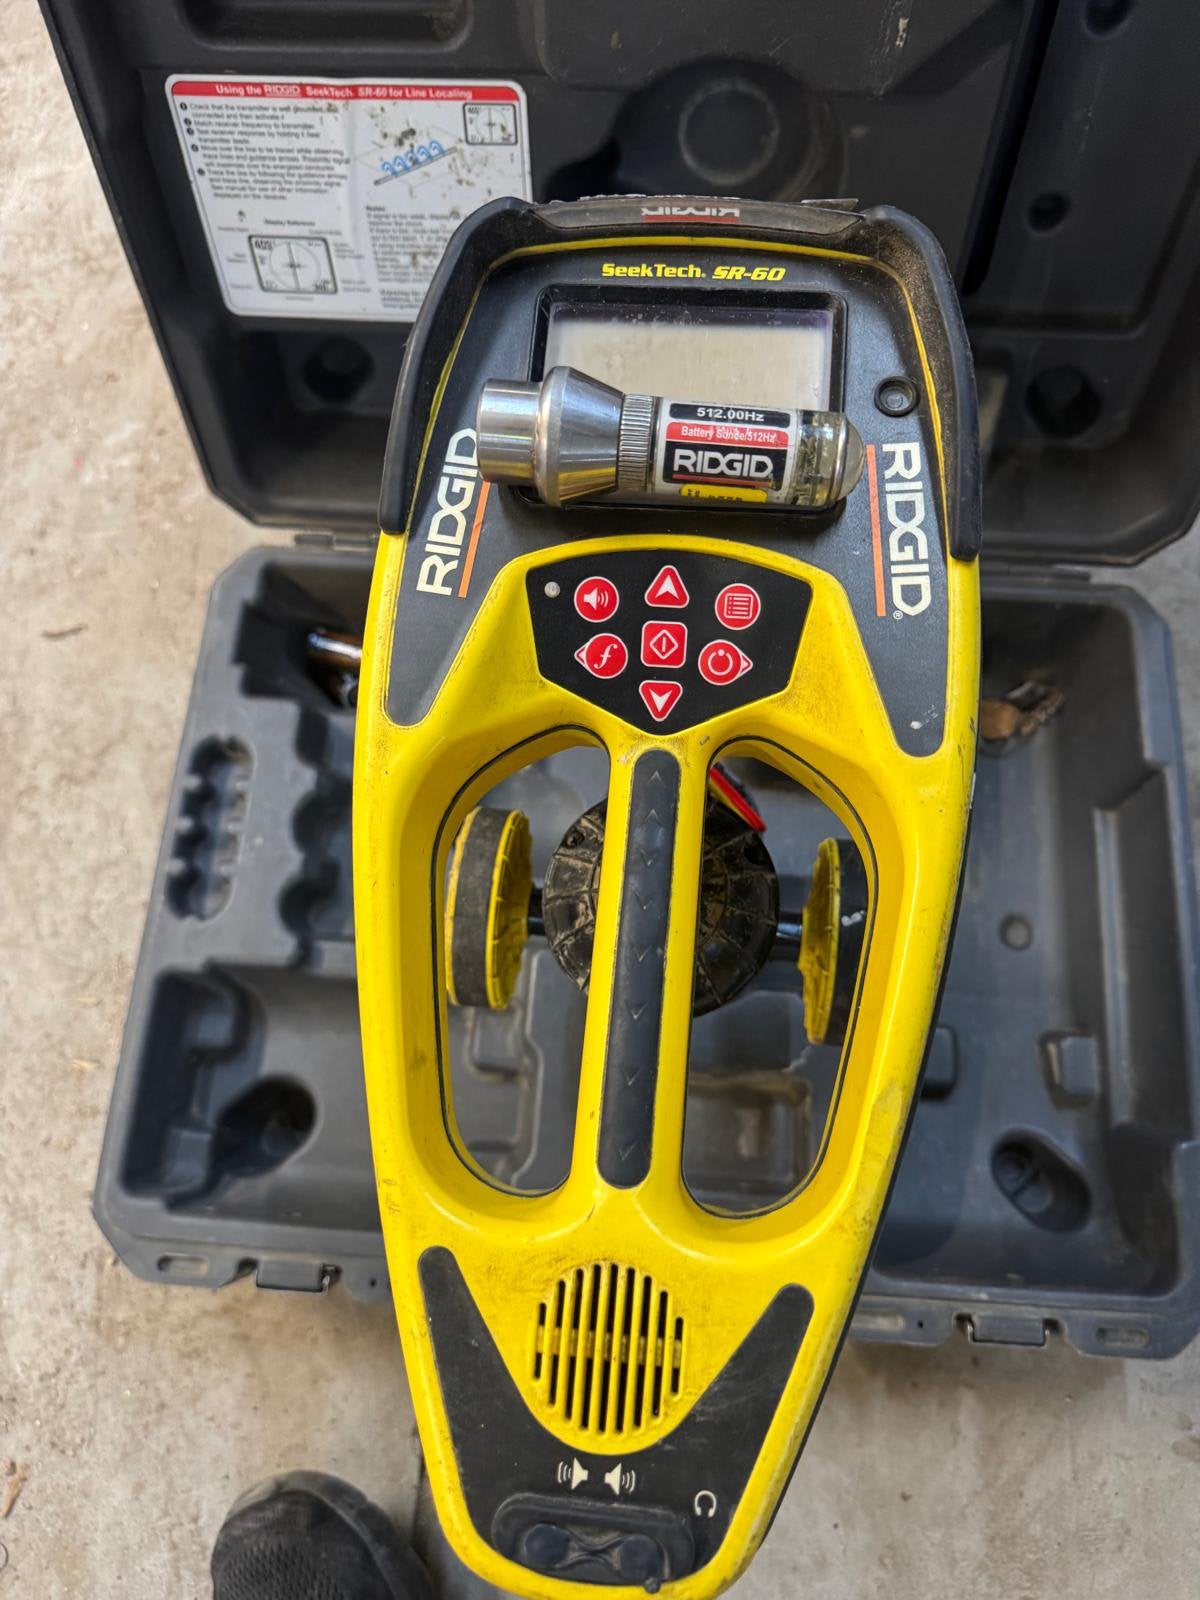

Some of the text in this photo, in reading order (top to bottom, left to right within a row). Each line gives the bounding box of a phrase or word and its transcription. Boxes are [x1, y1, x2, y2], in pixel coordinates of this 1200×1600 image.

[216, 84, 245, 96] Using
[246, 85, 262, 95] the
[264, 84, 300, 96] RIDGID
[358, 87, 388, 97] SR-60
[389, 87, 403, 97] for
[405, 87, 427, 98] Line
[429, 88, 473, 100] Locating
[712, 265, 786, 281] SR-60
[696, 407, 765, 422] 512.00Hz
[681, 426, 715, 440] Battery
[673, 448, 774, 478] RIDGID
[416, 428, 479, 596] RIDGID
[882, 442, 932, 617] RIDGID
